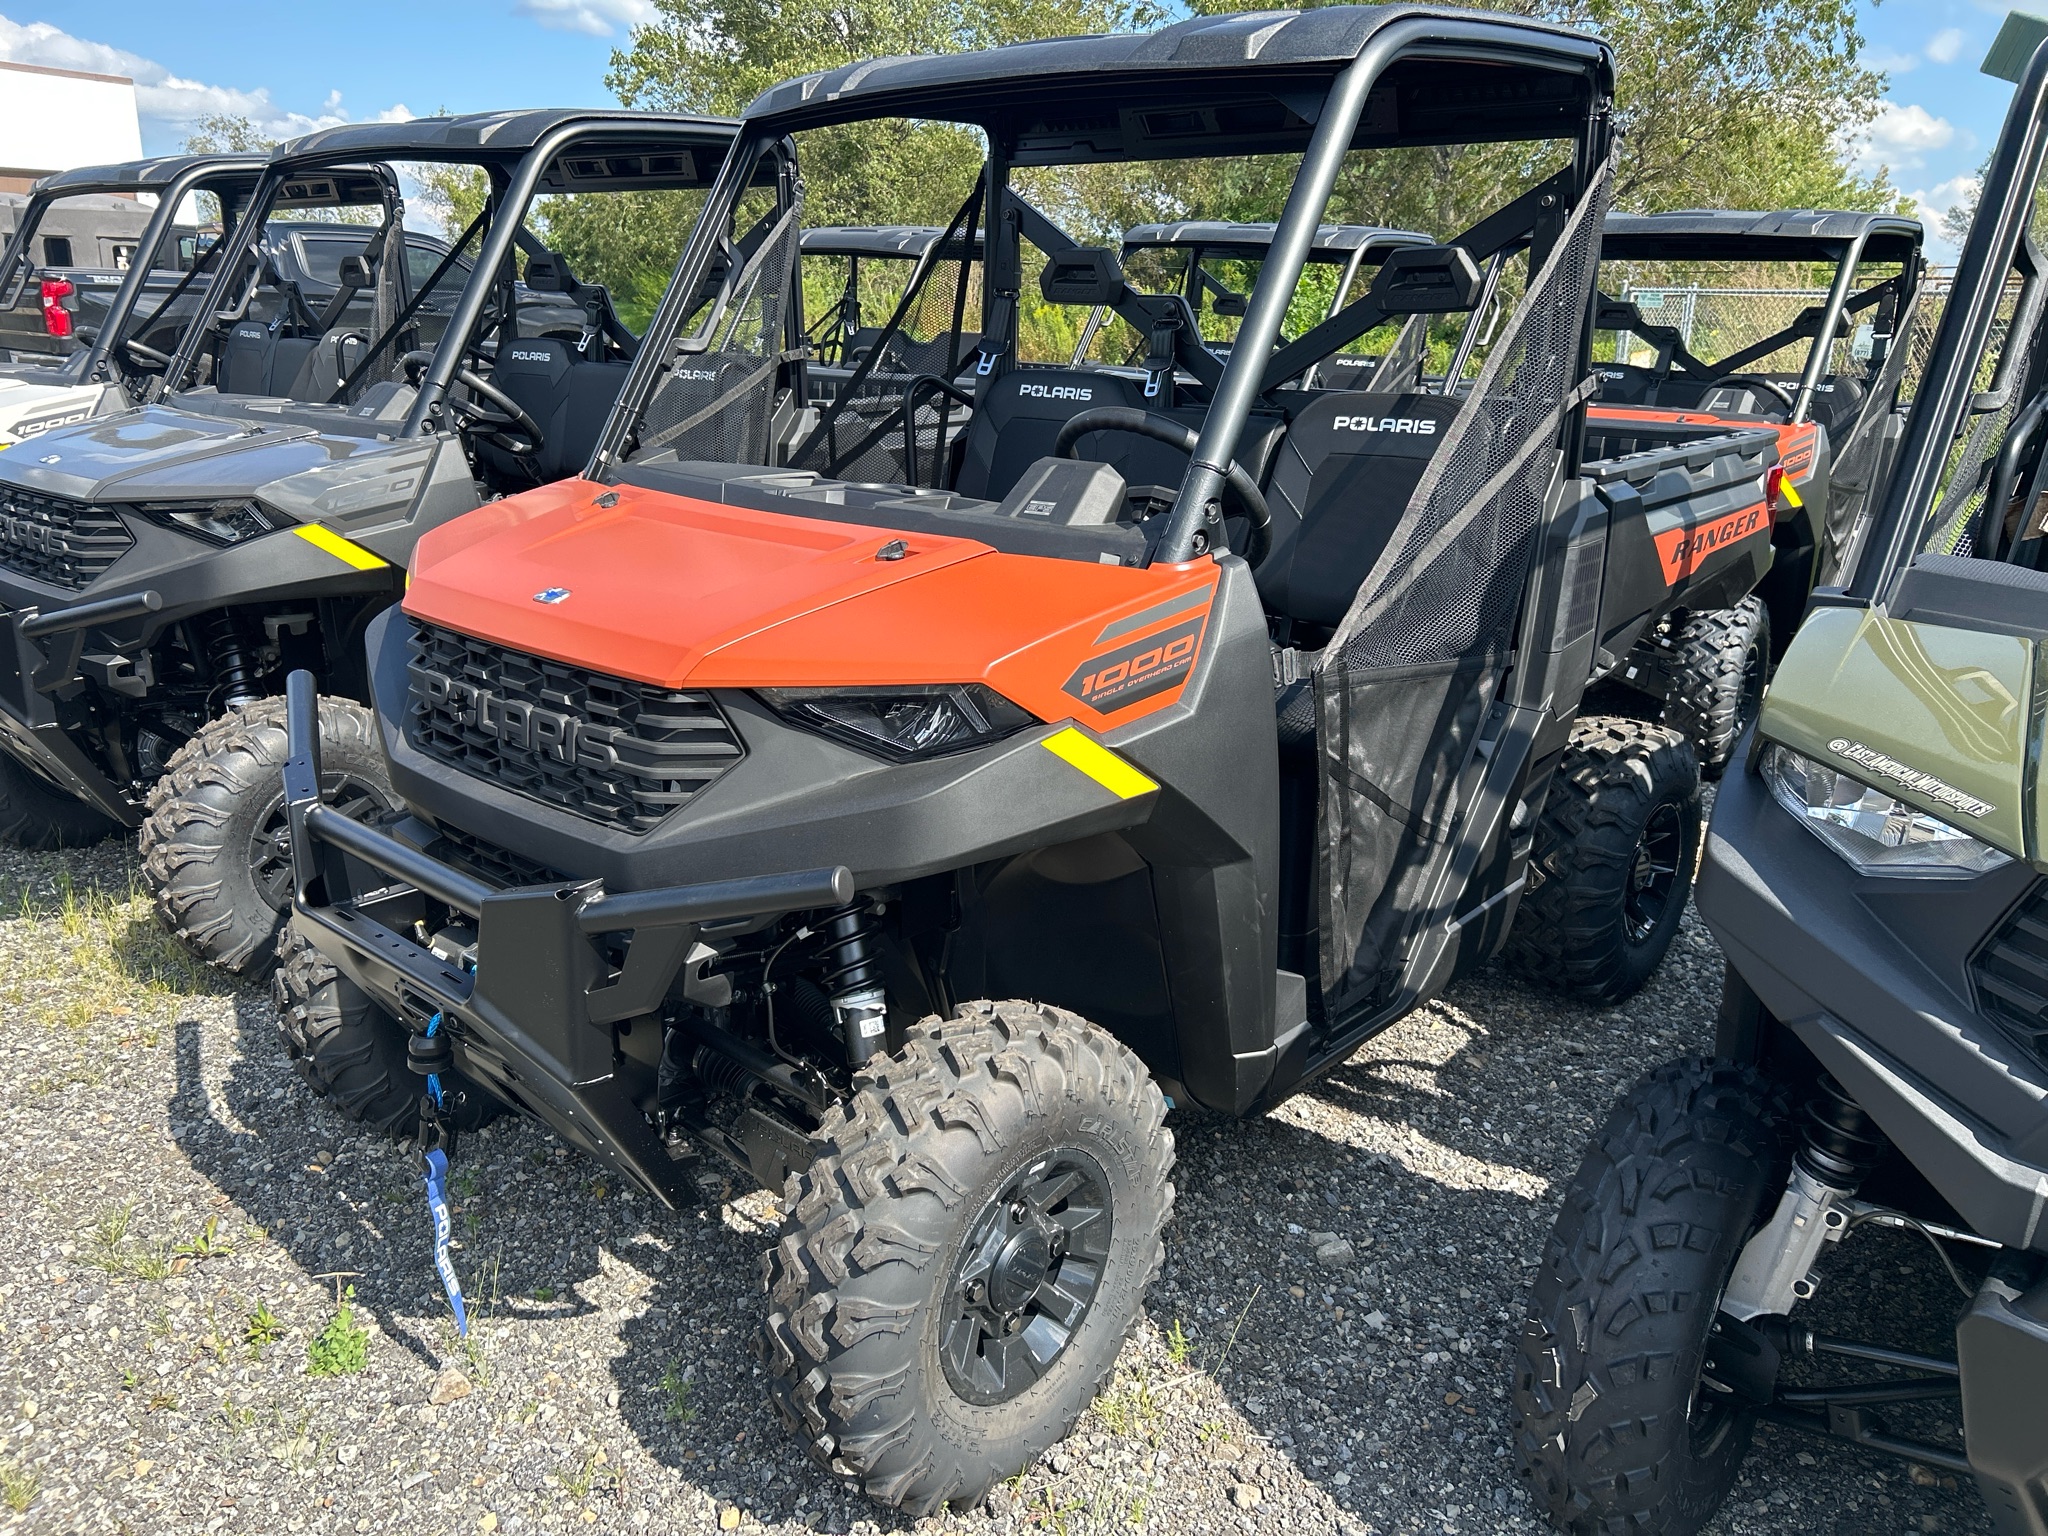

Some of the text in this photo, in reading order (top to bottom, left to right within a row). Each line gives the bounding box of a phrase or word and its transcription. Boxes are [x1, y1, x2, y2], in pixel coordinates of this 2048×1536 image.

[239, 330, 261, 339] POLARIS
[512, 350, 551, 362] POLARIS
[1335, 359, 1376, 368] POLARIS
[1019, 384, 1093, 401] POLARIS
[17, 413, 86, 435] 1000
[1332, 416, 1437, 435] POLARIS
[1783, 449, 1811, 468] 1000
[1670, 510, 1760, 565] RANGER
[1081, 633, 1195, 697] 1000
[1091, 656, 1192, 702] SINGLE OVERHEAD CAM
[424, 669, 622, 773] POLARIS
[756, 1121, 814, 1161] POLAR
[434, 1203, 461, 1297] POLARIS
